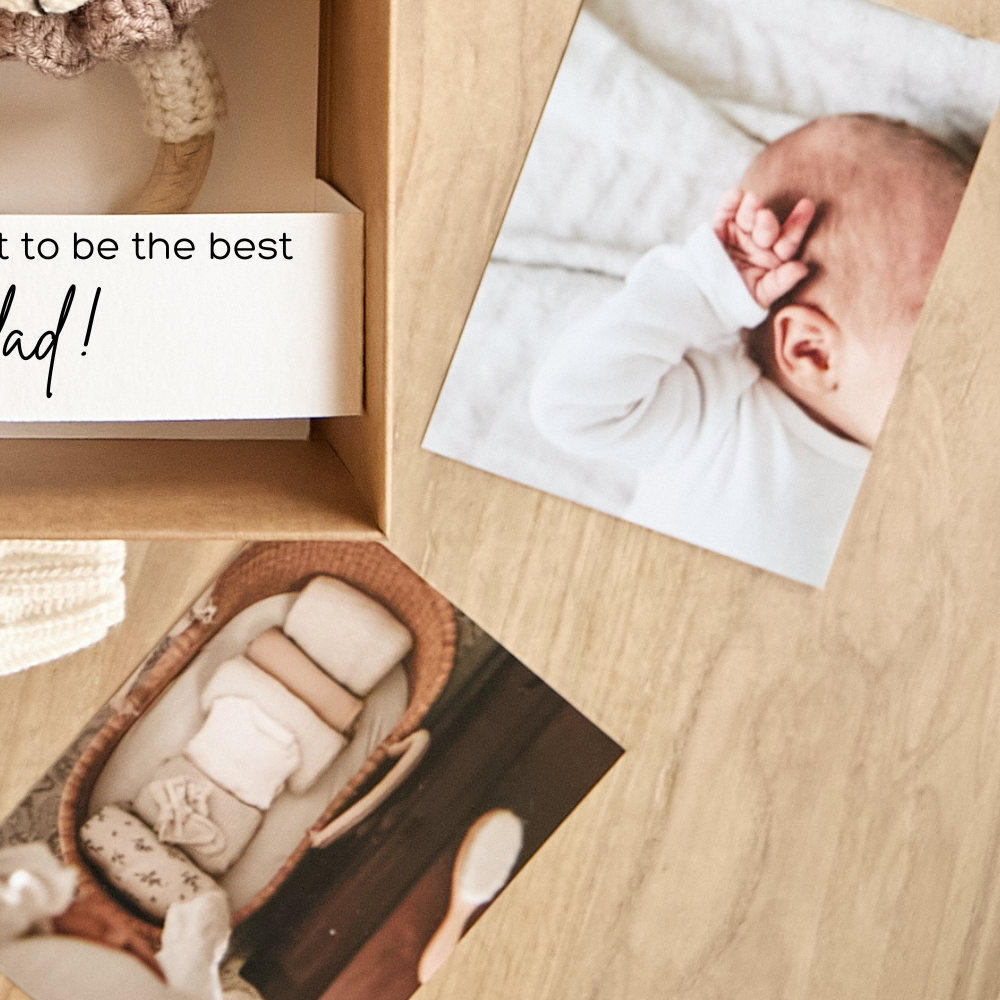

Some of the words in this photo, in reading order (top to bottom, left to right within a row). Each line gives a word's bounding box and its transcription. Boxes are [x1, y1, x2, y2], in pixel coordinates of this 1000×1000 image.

[20, 231, 59, 260] to
[73, 231, 119, 260] be
[131, 231, 196, 260] the
[210, 231, 294, 260] best
